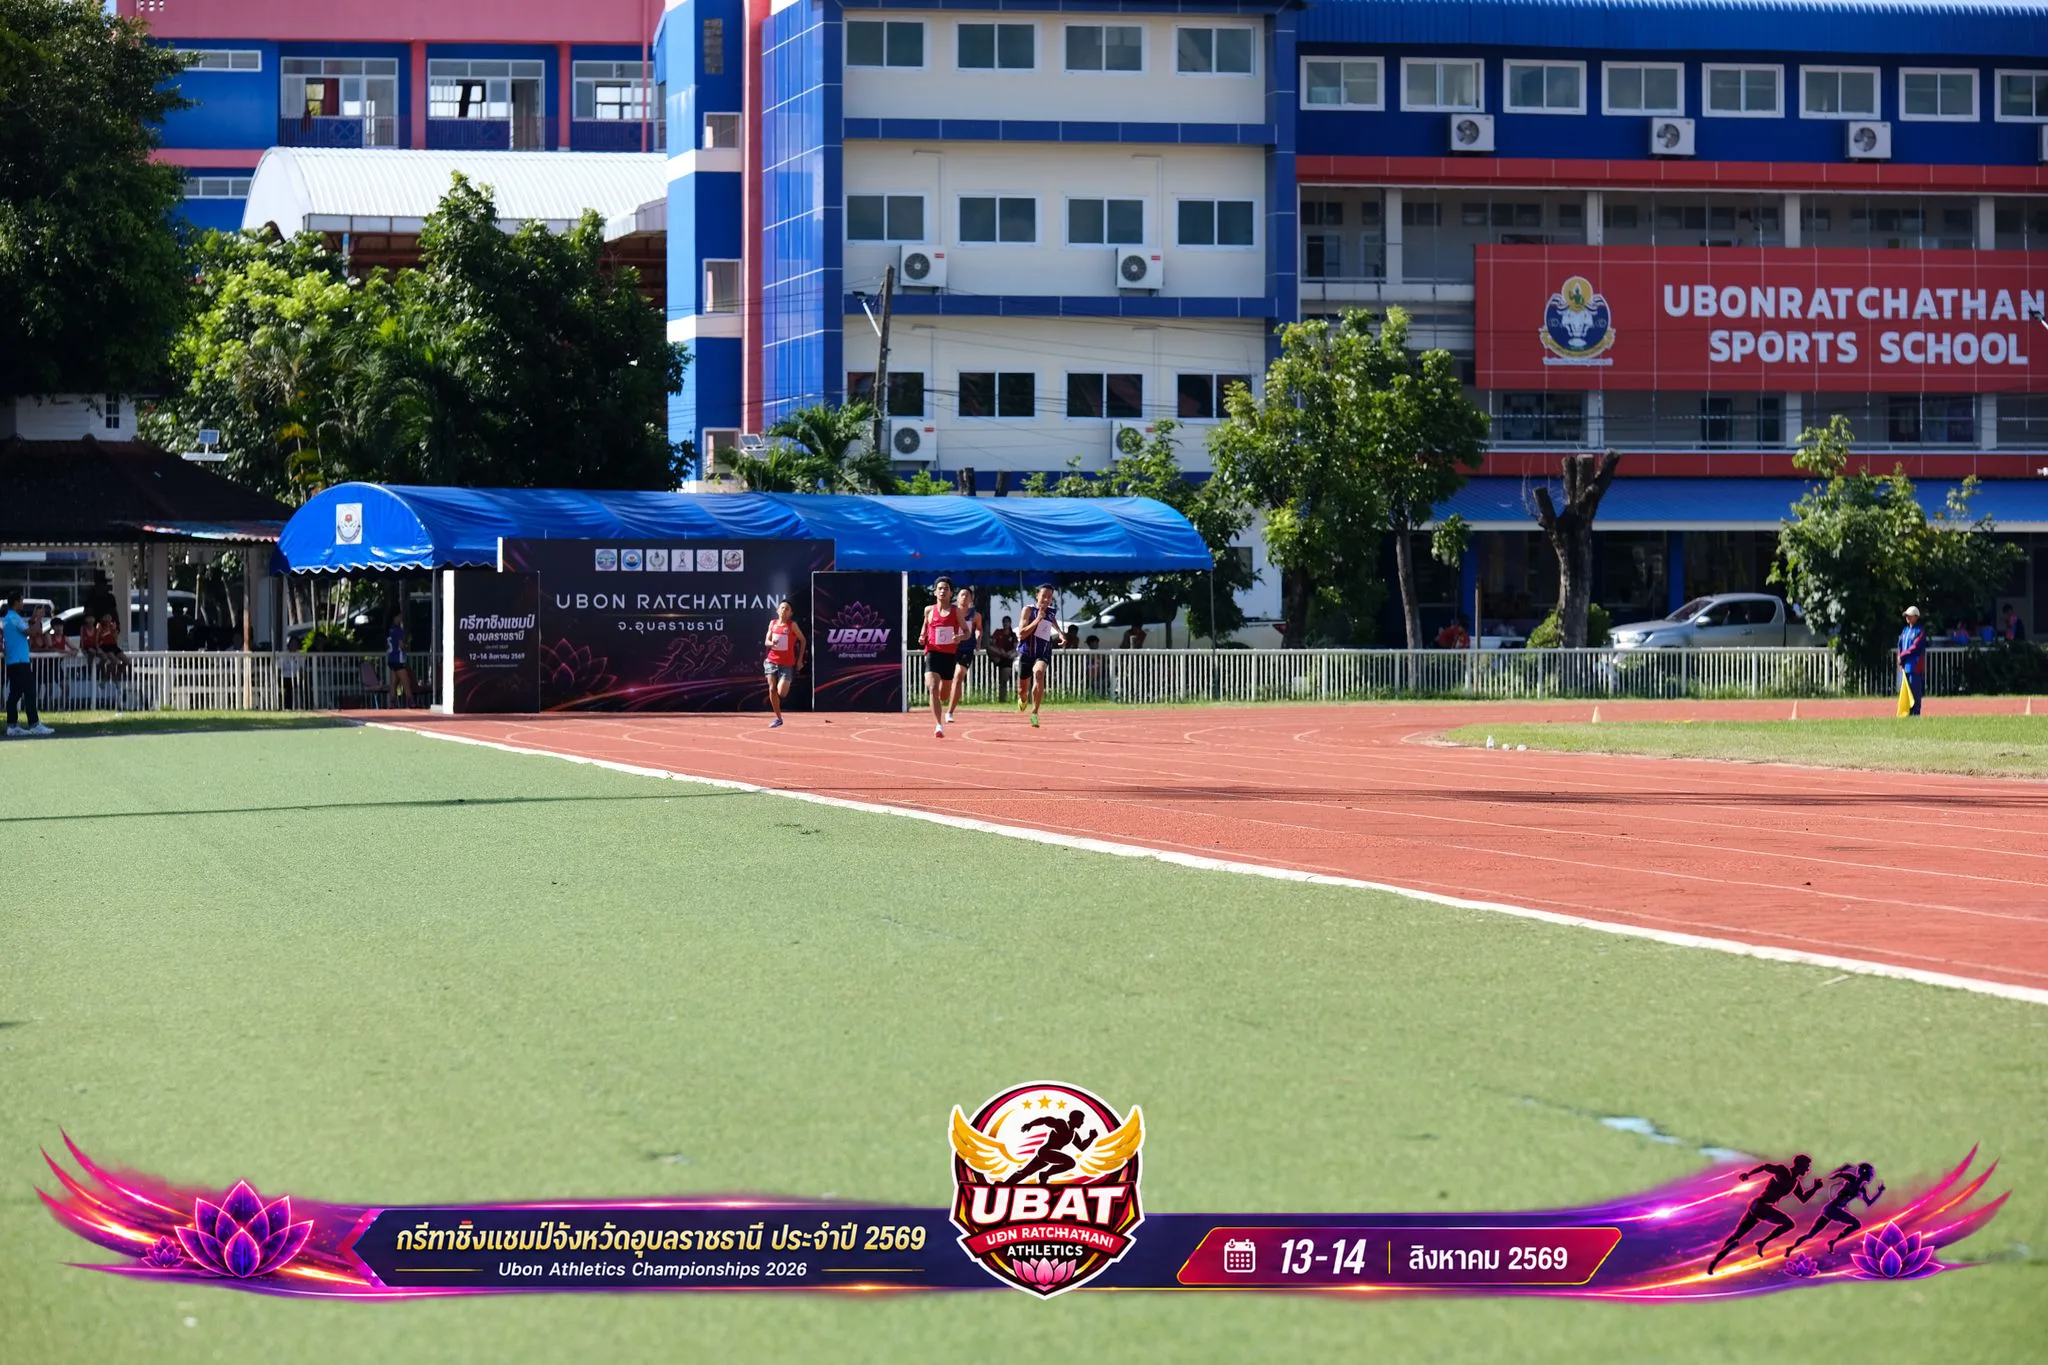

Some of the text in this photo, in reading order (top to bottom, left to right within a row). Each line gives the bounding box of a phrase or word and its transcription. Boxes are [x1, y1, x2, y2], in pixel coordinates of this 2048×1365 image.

[1709, 329, 2029, 365] SPORTS SCHOOL
[556, 593, 626, 609] UBON
[827, 628, 891, 643] UBON
